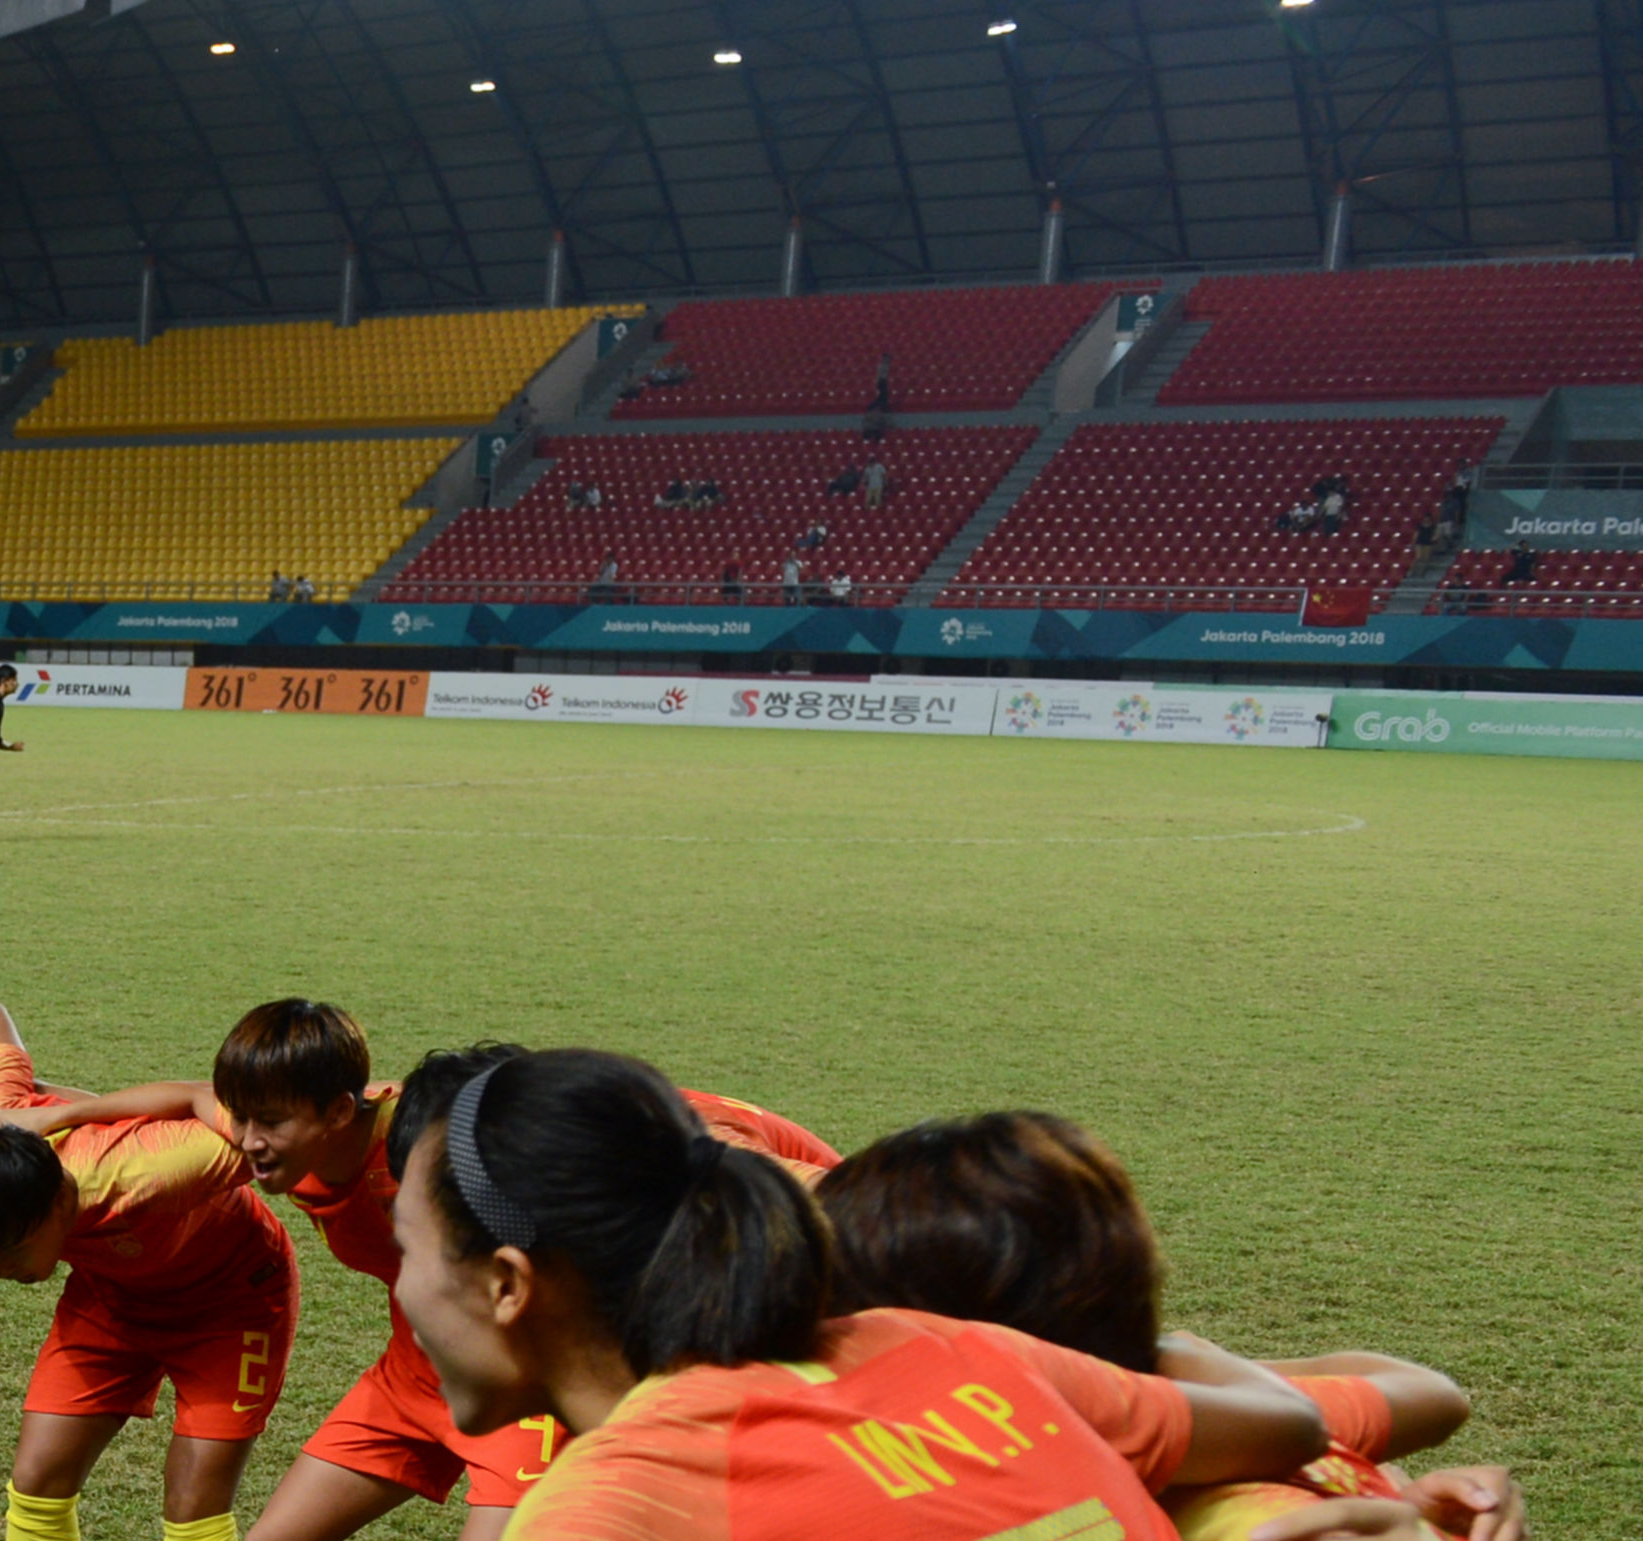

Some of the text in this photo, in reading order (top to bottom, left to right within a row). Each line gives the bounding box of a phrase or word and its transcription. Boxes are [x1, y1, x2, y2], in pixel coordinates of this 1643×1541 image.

[1505, 516, 1596, 535] Jakarta
[117, 616, 239, 630] Jakarta Palembang 2018
[603, 620, 751, 636] Jakarta Palembang 2018
[1200, 630, 1384, 647] Jakarta Palembang 2018
[56, 684, 132, 697] PERTAMINA
[433, 693, 524, 707] Telkom Indonesia
[562, 697, 657, 711] Telkom Indonesia
[763, 690, 955, 725] 쌍용정보통신
[1354, 708, 1451, 743] Grab
[238, 1331, 270, 1396] 2
